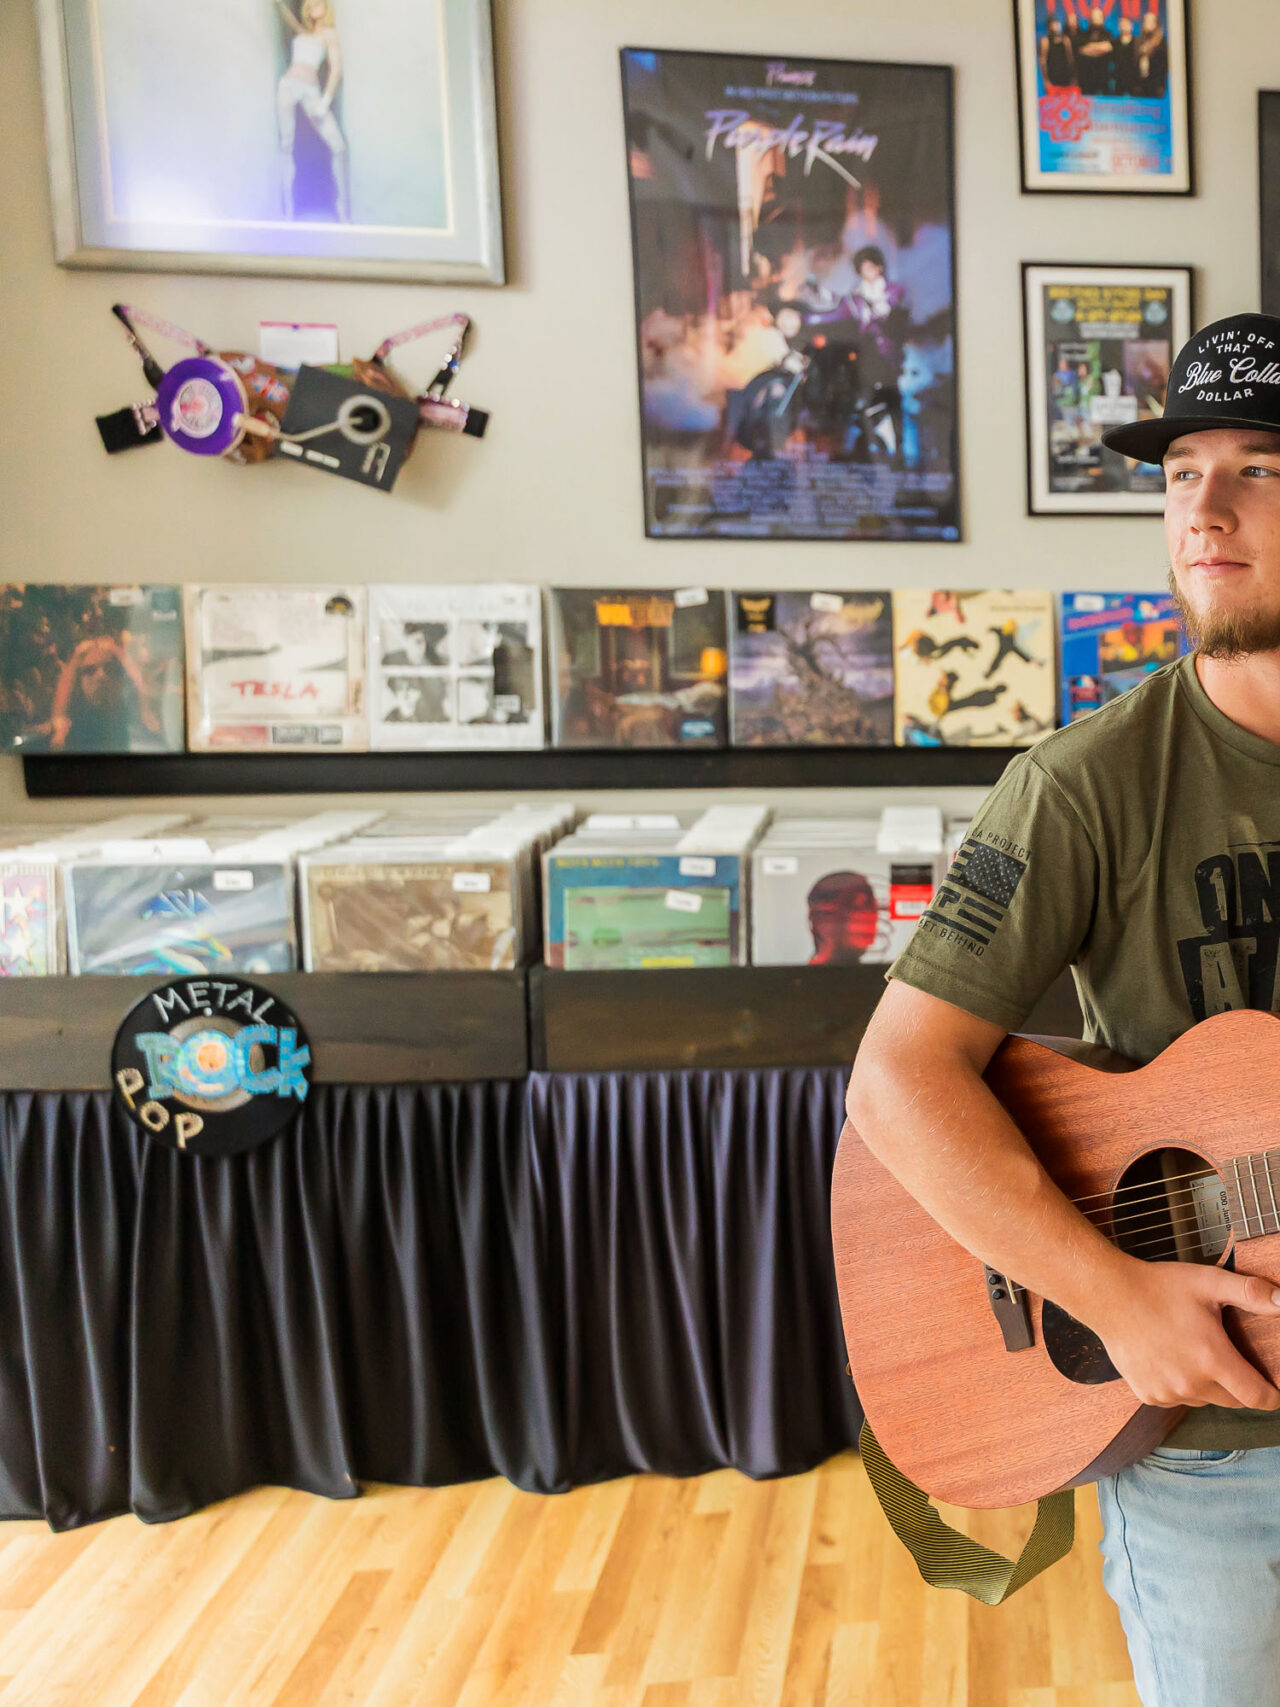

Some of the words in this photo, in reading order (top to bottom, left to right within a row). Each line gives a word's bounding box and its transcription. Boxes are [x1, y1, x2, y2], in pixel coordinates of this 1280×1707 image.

[704, 109, 809, 163] Purple
[804, 120, 879, 189] Rain
[1198, 330, 1241, 354] LIVIN'
[1247, 332, 1276, 350] OFF
[1216, 343, 1250, 354] THAT
[1178, 361, 1222, 394] Blue
[1196, 387, 1254, 402] DOLLAR
[230, 680, 319, 701] TESLA
[987, 832, 1032, 862] PROJECT
[939, 927, 985, 957] BEHIND
[152, 981, 275, 1025] METAL
[135, 1024, 311, 1103] ROCK
[116, 1067, 204, 1149] POP
